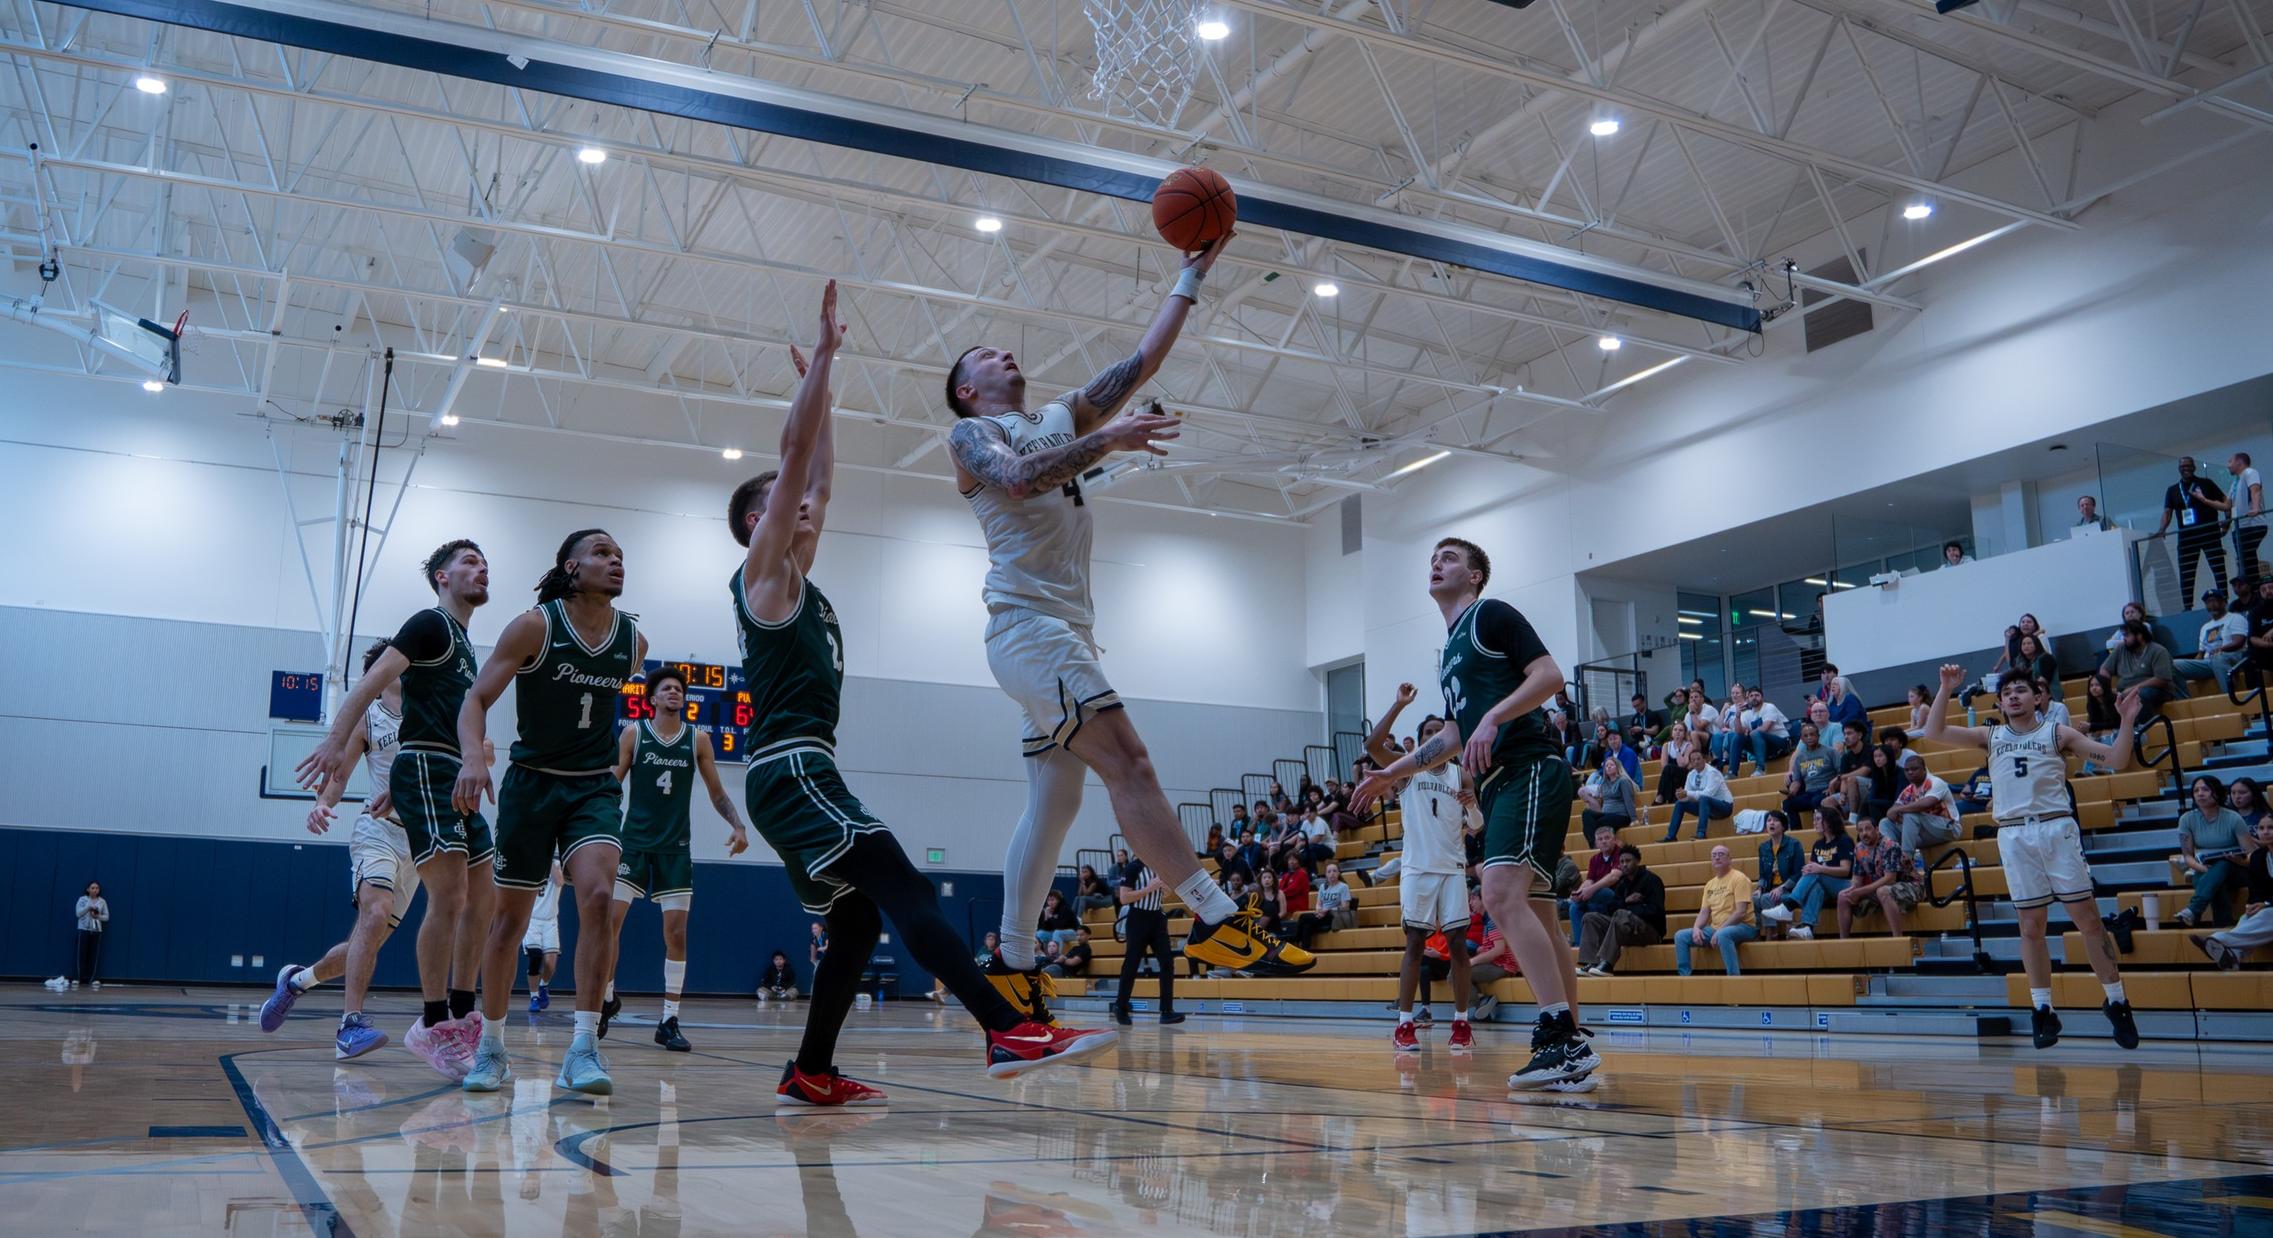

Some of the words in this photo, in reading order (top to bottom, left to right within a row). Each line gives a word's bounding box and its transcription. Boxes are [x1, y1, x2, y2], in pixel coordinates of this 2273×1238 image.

[1062, 478, 1084, 507] 4
[826, 631, 842, 672] 2
[281, 675, 319, 692] 10:15
[552, 663, 623, 690] Pioneers
[577, 692, 593, 728] 1
[687, 702, 699, 720] 2
[723, 734, 735, 751] 3
[642, 751, 689, 767] Pioneers
[2014, 756, 2028, 778] 5
[656, 770, 672, 795] 4
[1432, 797, 1438, 818] 1
